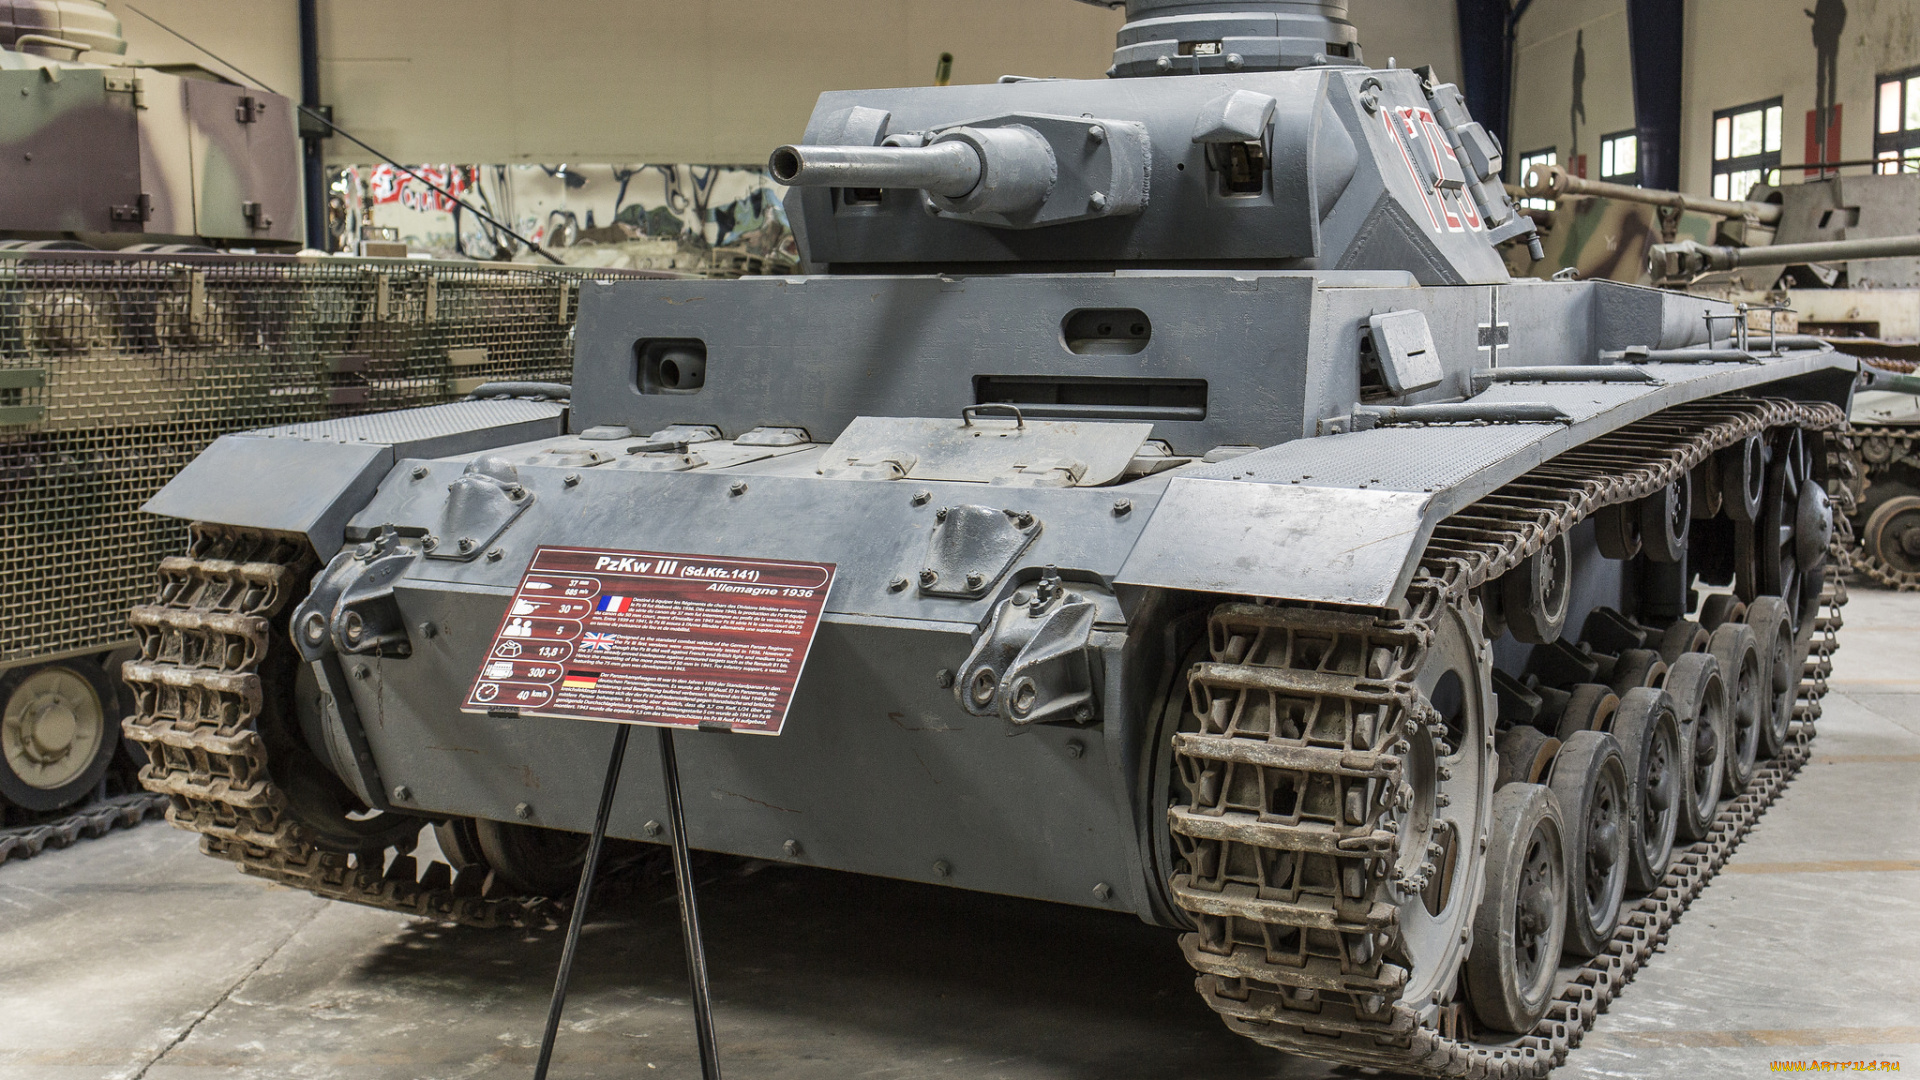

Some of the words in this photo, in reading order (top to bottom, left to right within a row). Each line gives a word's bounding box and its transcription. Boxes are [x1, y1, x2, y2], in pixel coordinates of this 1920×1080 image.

[595, 557, 651, 573] PzKw
[654, 560, 678, 575] III
[680, 565, 760, 582] (Sd.Kfz.141)
[568, 579, 579, 587] 37
[706, 583, 778, 596] Allemagne
[782, 588, 813, 598] 1936
[558, 604, 571, 614] 30
[556, 625, 565, 635] 5
[539, 646, 559, 658] 13,8
[527, 667, 546, 678] 300
[516, 690, 530, 700] 40
[530, 689, 548, 698] km/h
